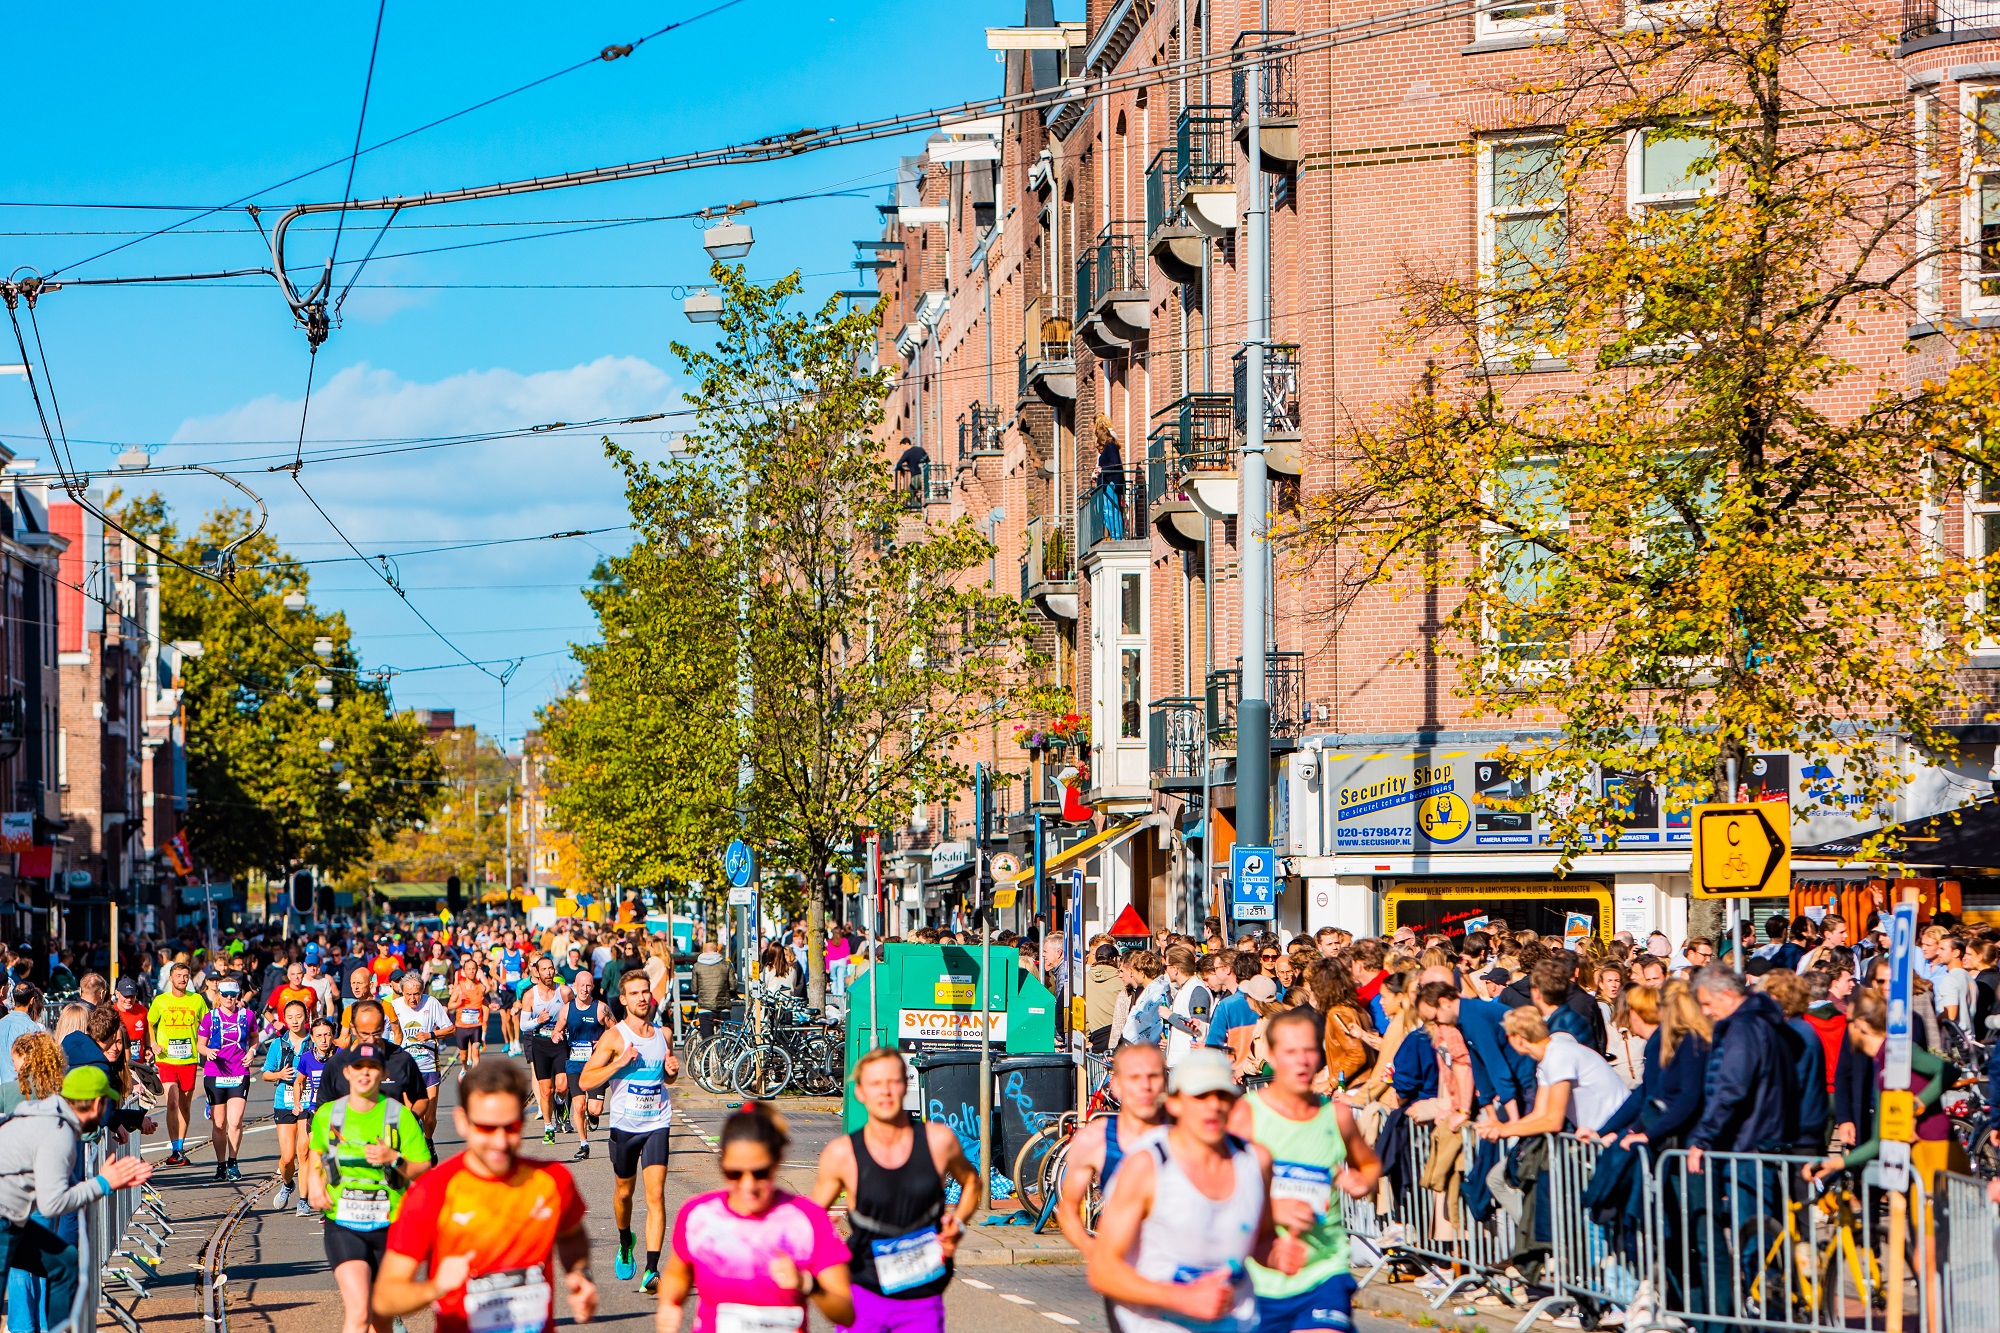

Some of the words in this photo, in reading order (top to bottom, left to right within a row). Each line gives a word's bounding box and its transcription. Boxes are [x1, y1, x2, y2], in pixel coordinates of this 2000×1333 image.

[1340, 777, 1407, 806] Security
[1413, 765, 1451, 786] Shop
[1341, 809, 1350, 818] De
[1352, 802, 1379, 814] sleutel
[1381, 798, 1393, 807] tot
[1409, 784, 1452, 800] beveiliging
[1337, 827, 1412, 838] 020-6798472
[1726, 820, 1741, 847] C
[1337, 838, 1412, 847] WWW.SECUSHOP.NL
[1501, 835, 1529, 843] BEWAKING
[934, 851, 963, 862] Asahi
[1404, 886, 1453, 896] INBRAAKWERENDE
[1455, 886, 1475, 896] SLOTEN
[1478, 885, 1521, 895] ALARMSYSTEMEN
[1526, 885, 1548, 894] KLUIZEN
[1553, 885, 1590, 894] BRANDKASTEN
[904, 1013, 1000, 1029] SYMPANY
[346, 1201, 381, 1210] LOUISE
